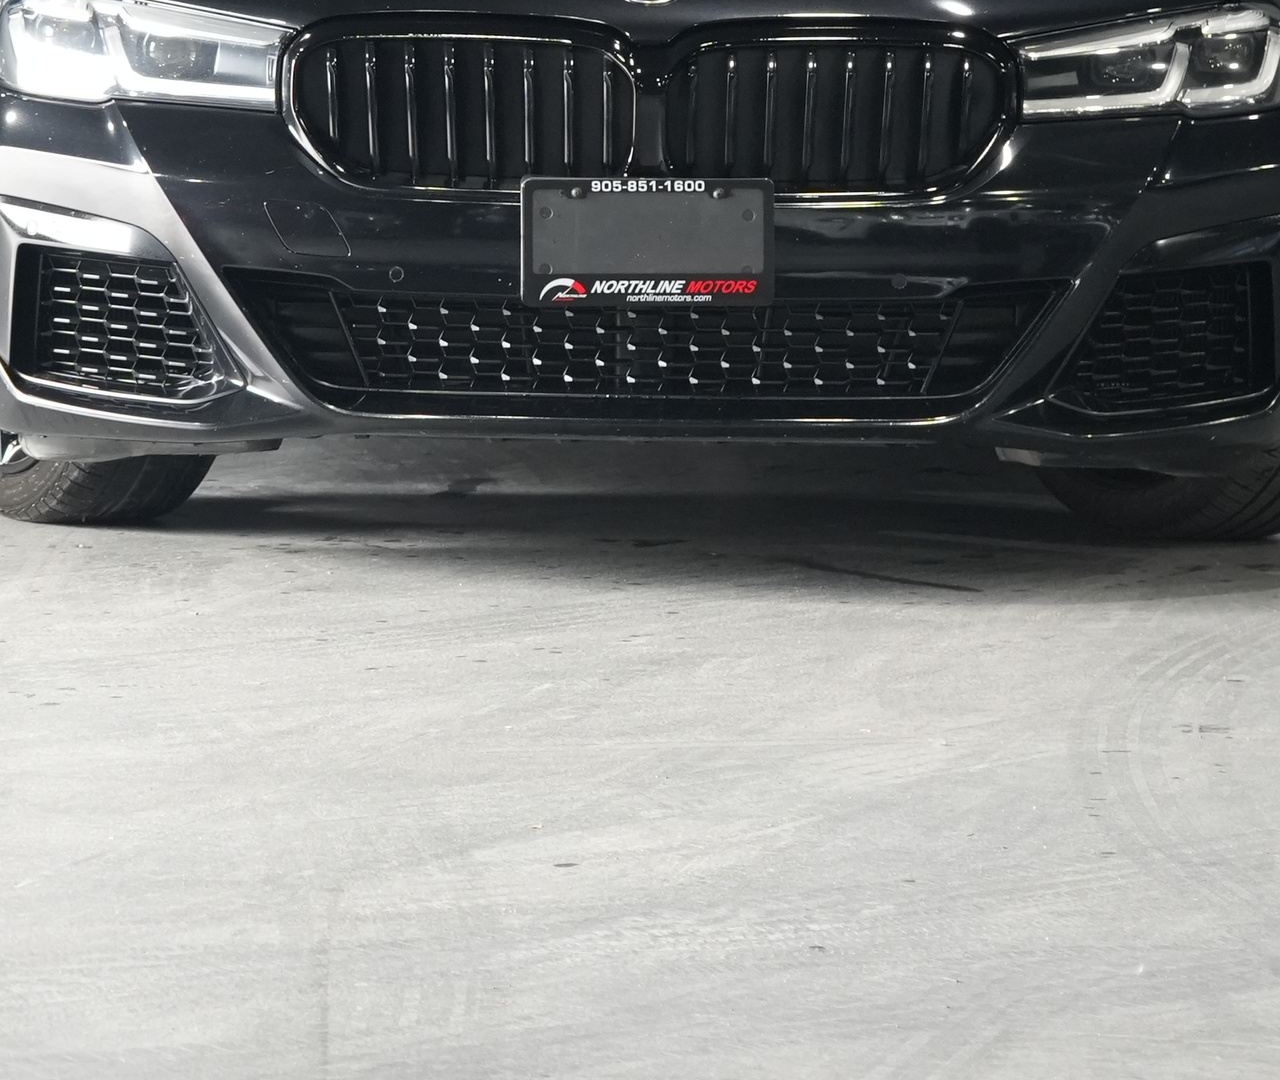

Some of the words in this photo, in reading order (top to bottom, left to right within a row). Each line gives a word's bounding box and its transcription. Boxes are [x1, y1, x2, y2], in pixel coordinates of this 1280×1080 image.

[591, 180, 705, 192] 905-851-1600
[590, 280, 686, 294] NORTHLINE
[686, 280, 758, 294] MOTORS
[626, 294, 712, 302] northlinemotors.com
